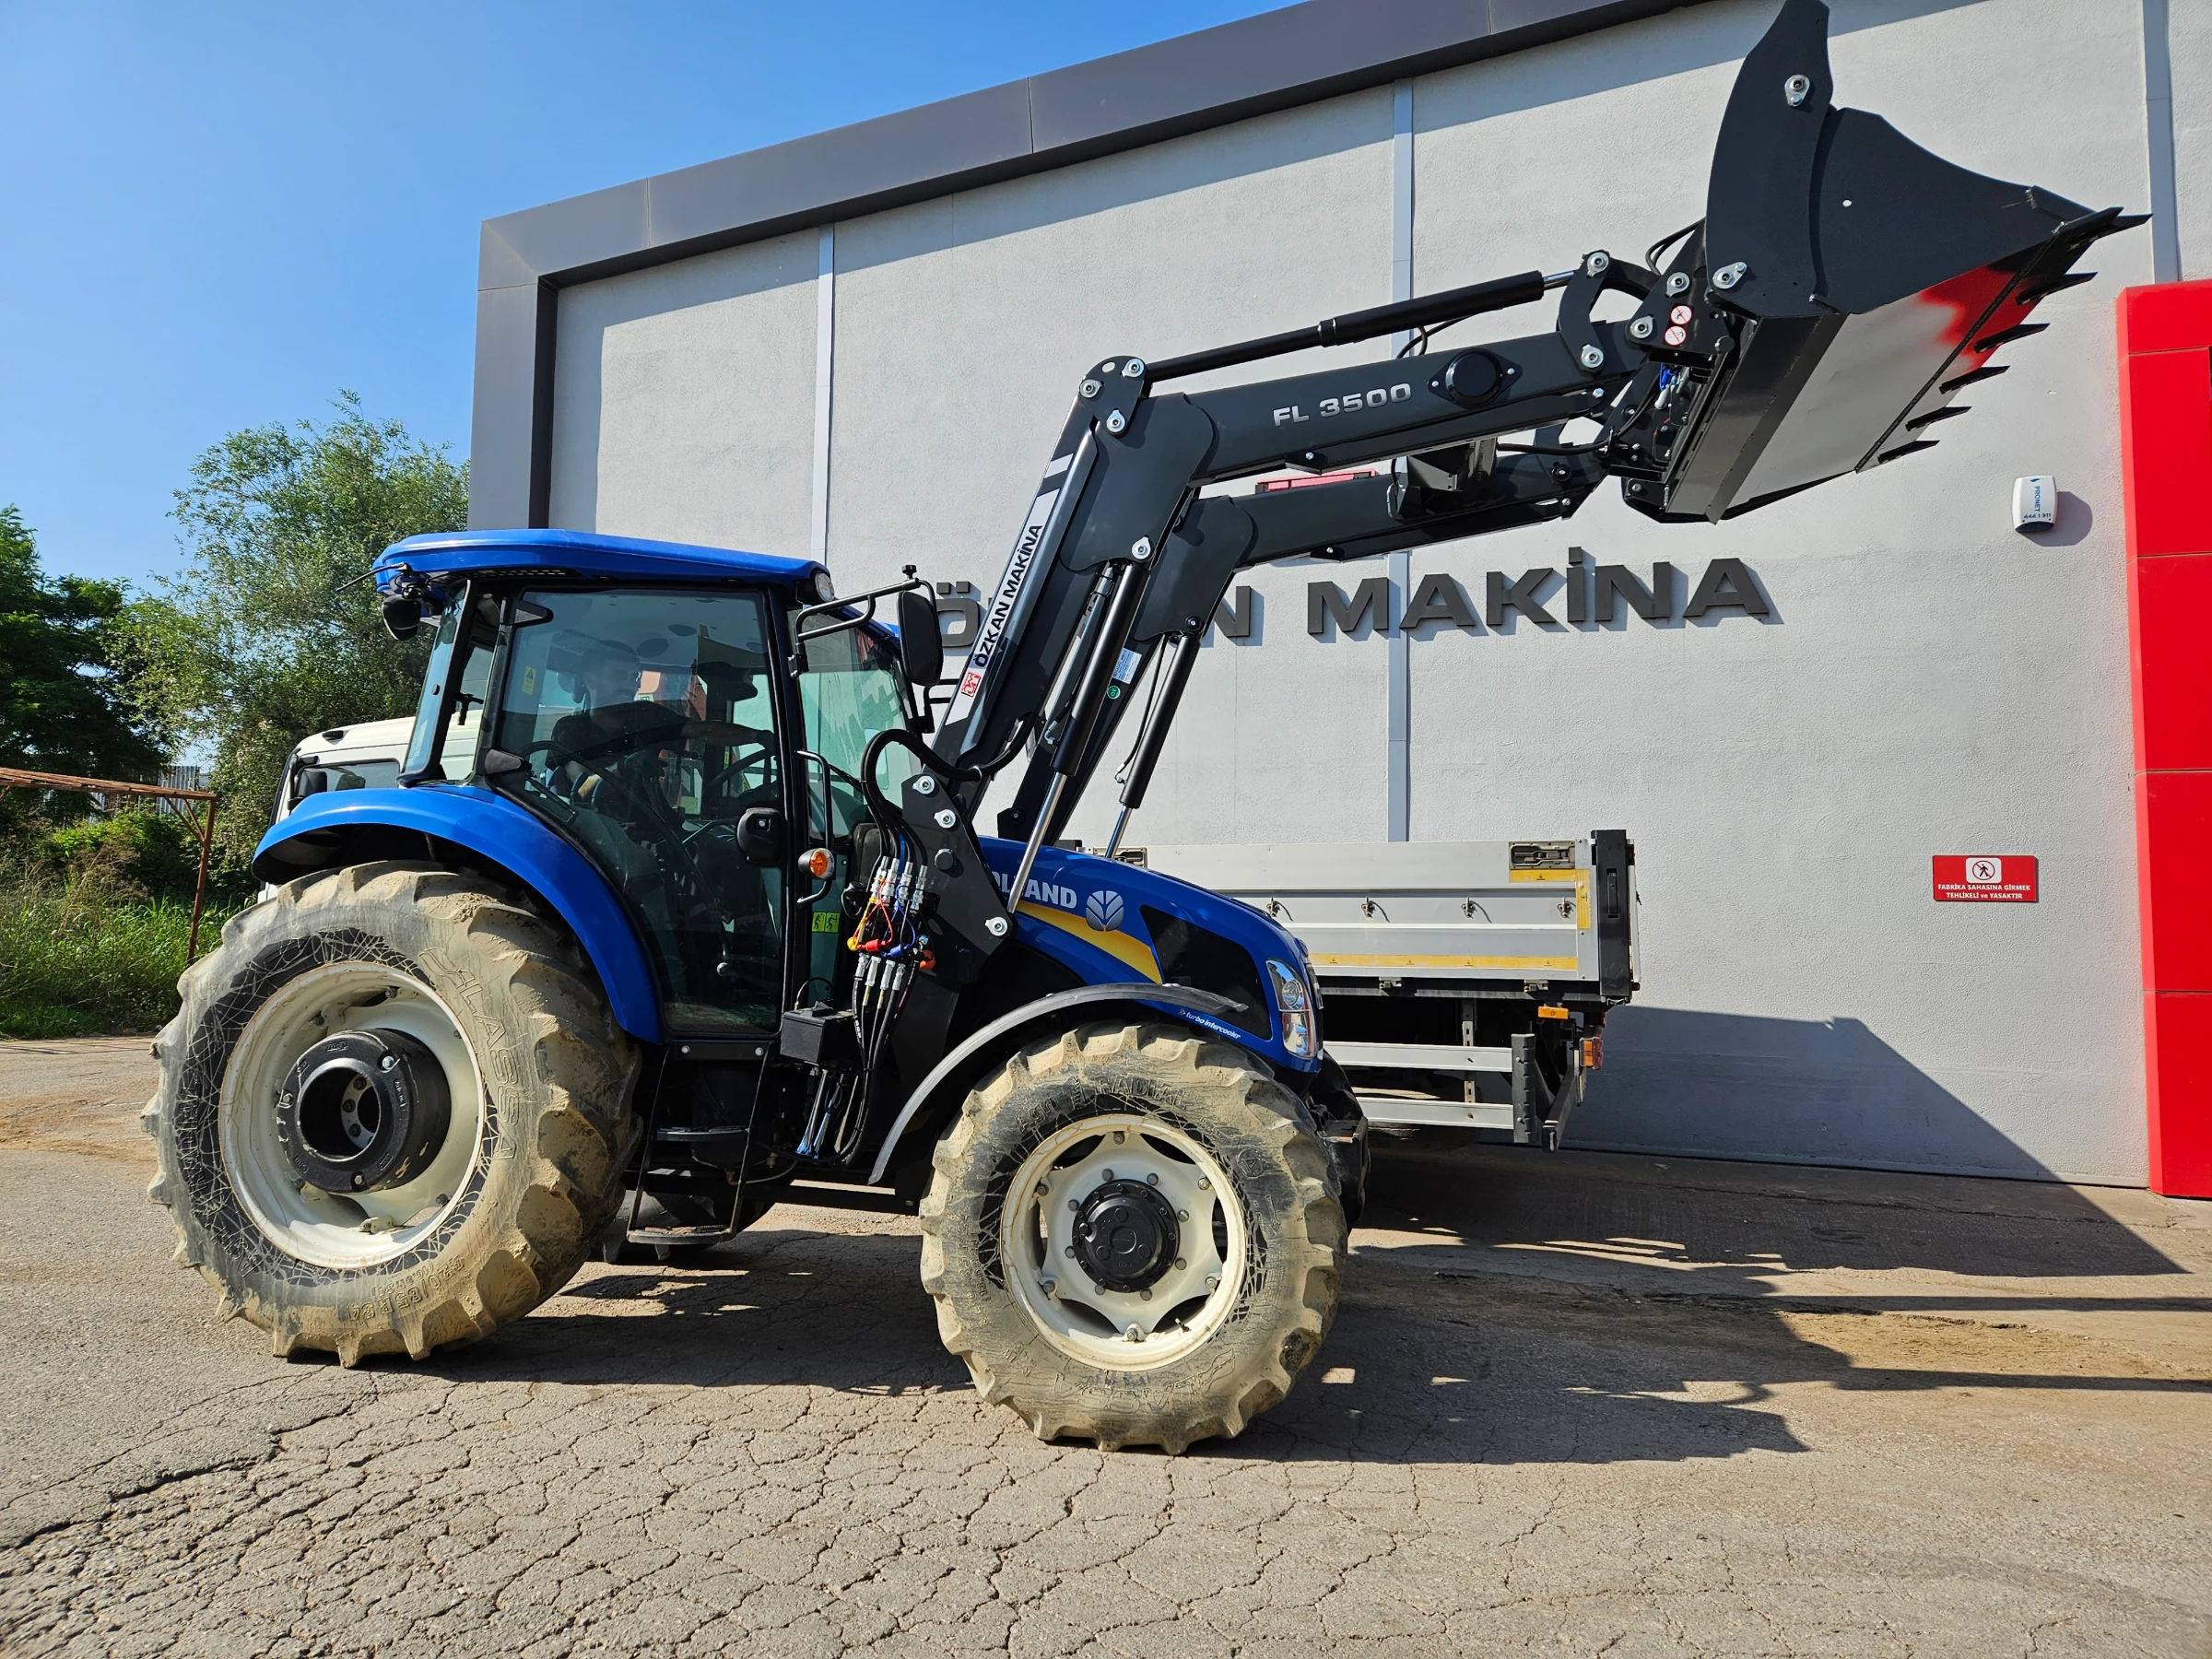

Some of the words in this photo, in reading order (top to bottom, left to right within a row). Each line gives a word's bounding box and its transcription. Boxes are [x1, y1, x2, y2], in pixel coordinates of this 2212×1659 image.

[1273, 405, 1310, 427] FL
[1319, 382, 1411, 418] 3500
[972, 601, 1010, 667] ÖZKAN
[1003, 524, 1043, 599] MAKİNA
[1307, 546, 1770, 635] MAKİNA
[438, 959, 519, 1160] LASSA
[1185, 1011, 1205, 1024] turbo
[1204, 1018, 1241, 1039] intercooler
